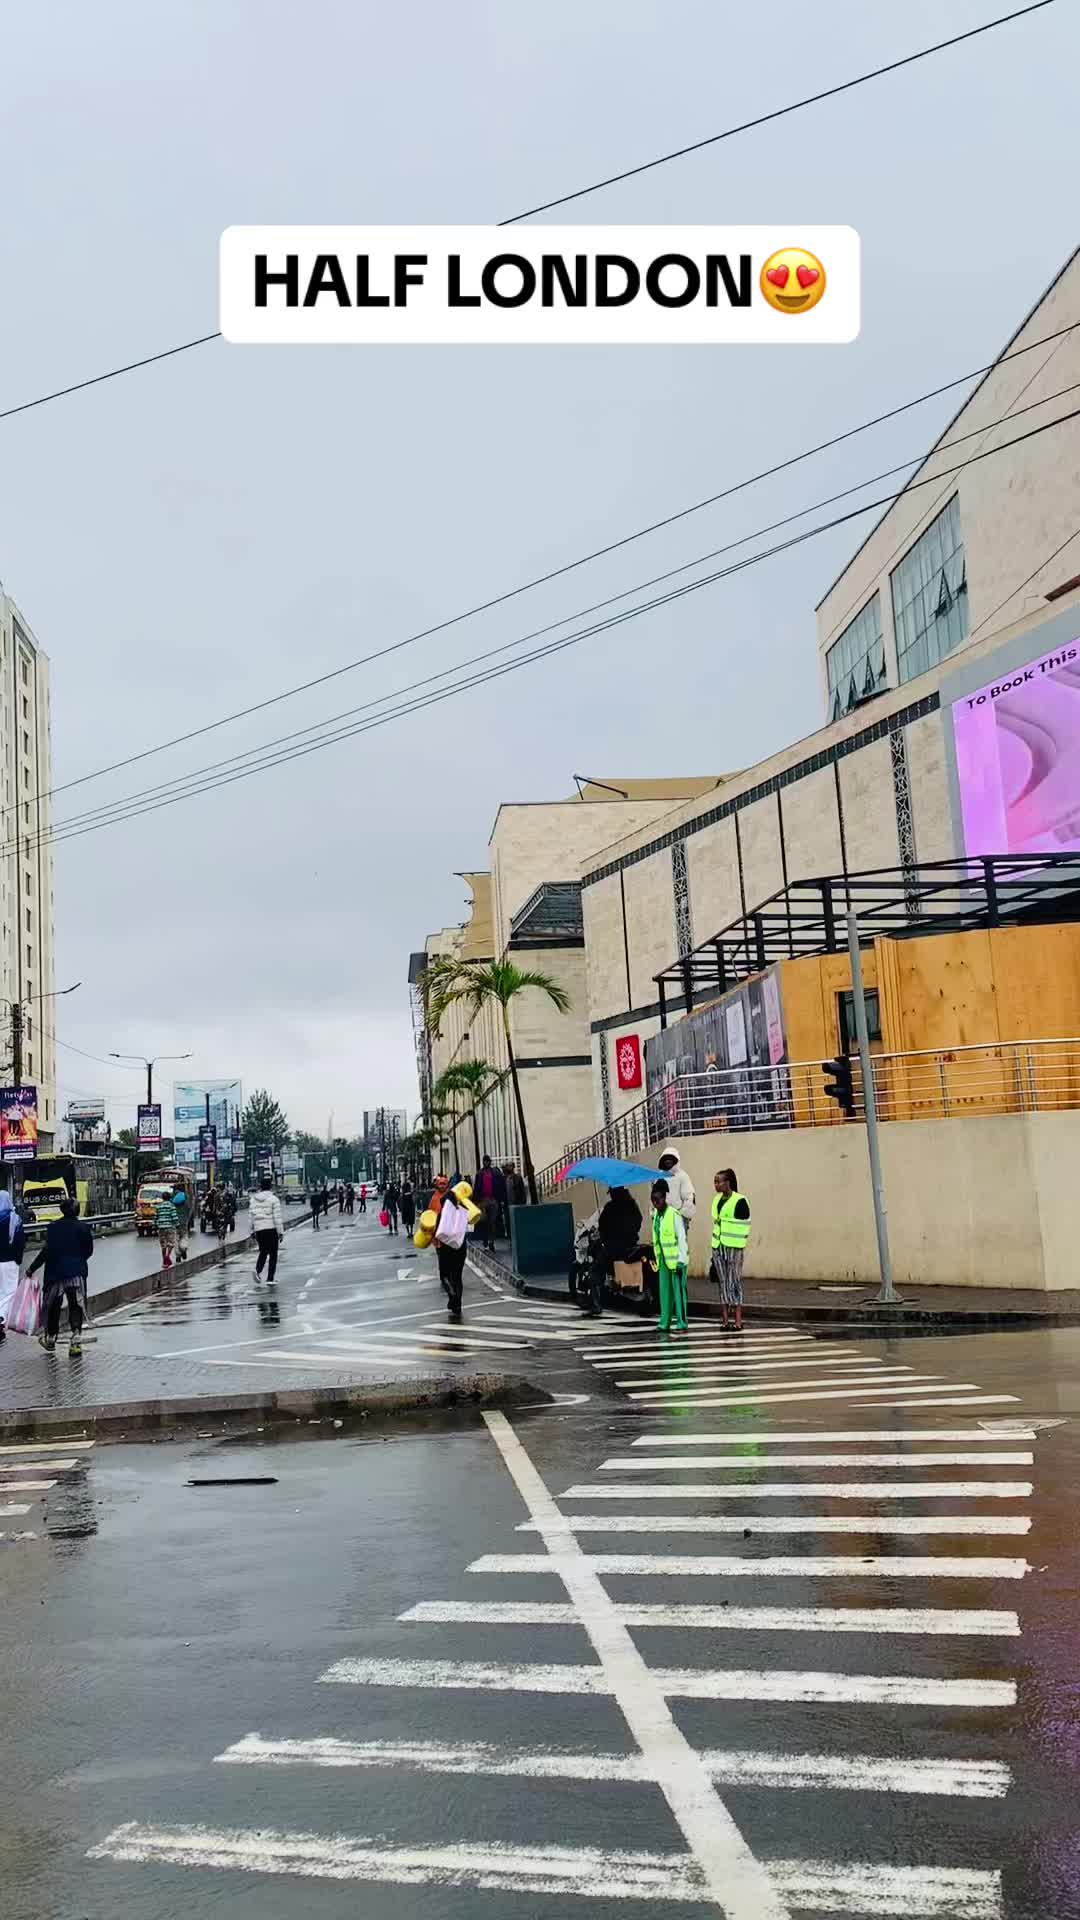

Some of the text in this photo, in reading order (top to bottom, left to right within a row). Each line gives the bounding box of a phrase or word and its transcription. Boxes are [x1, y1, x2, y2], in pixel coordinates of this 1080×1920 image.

[967, 648, 1077, 709] To Book This
